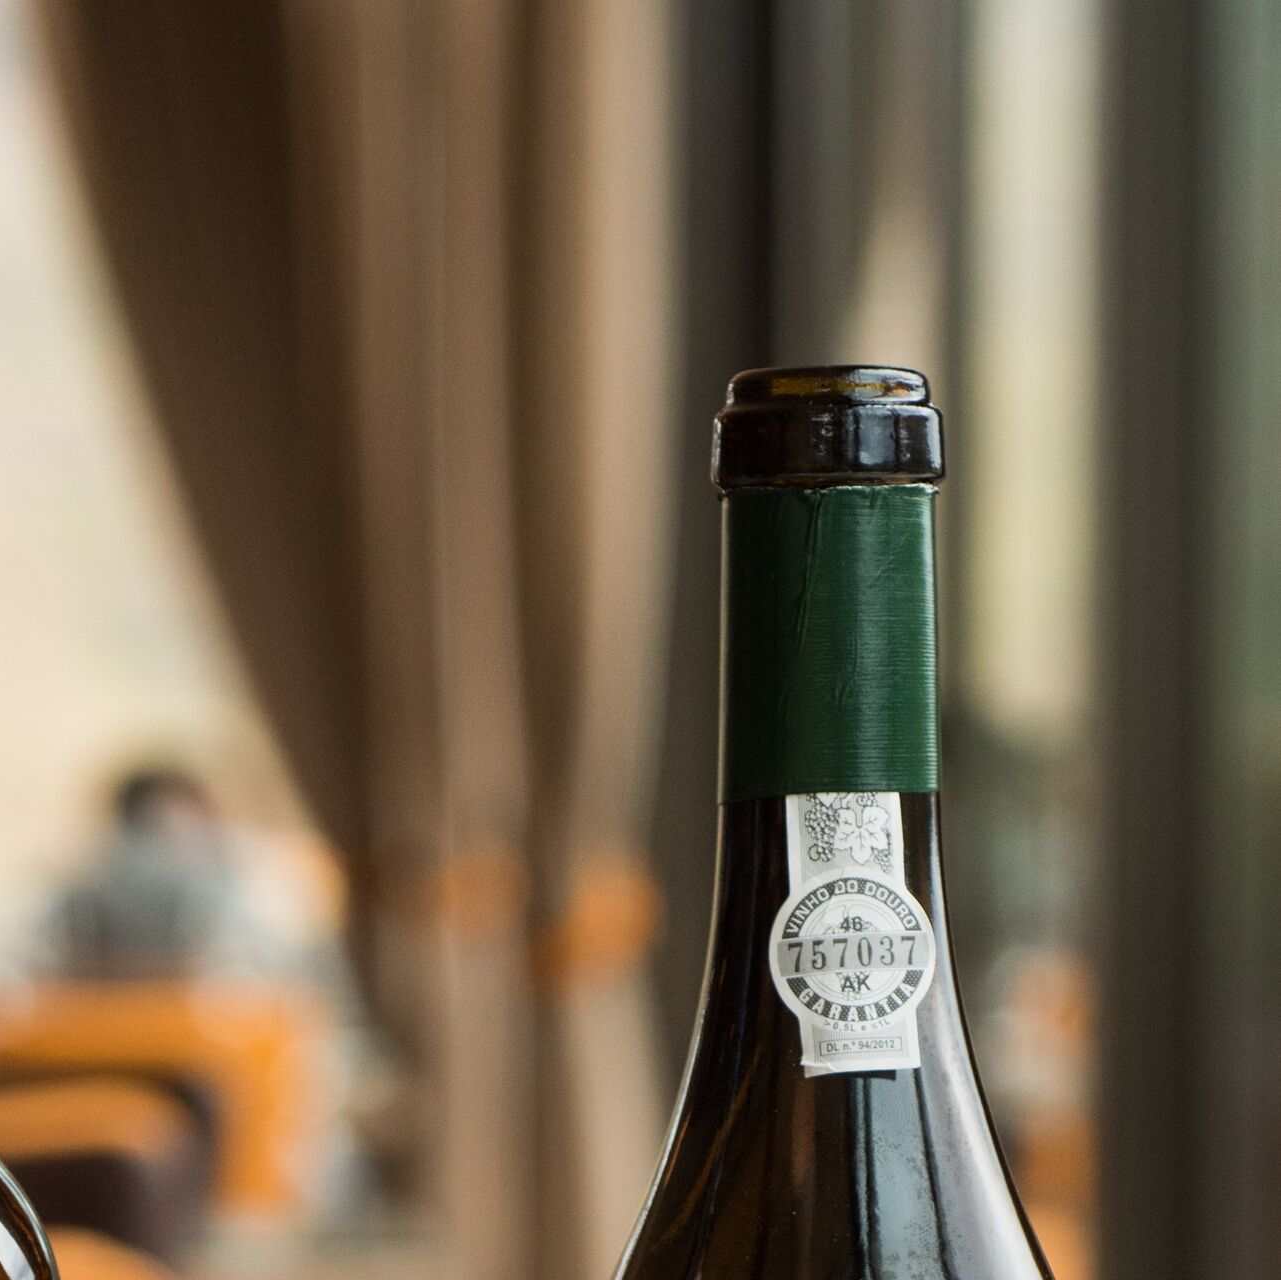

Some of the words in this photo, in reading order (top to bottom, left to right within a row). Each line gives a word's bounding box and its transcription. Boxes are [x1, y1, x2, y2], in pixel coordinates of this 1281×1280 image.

[785, 886, 828, 935] VINHO
[834, 880, 860, 895] DO
[865, 881, 918, 929] DOURO
[840, 917, 863, 932] 46
[788, 935, 917, 973] 757037
[840, 975, 871, 992] AK
[799, 984, 917, 1022] GARANTIA
[826, 1042, 840, 1053] DL
[859, 1039, 895, 1050] 94/2012
